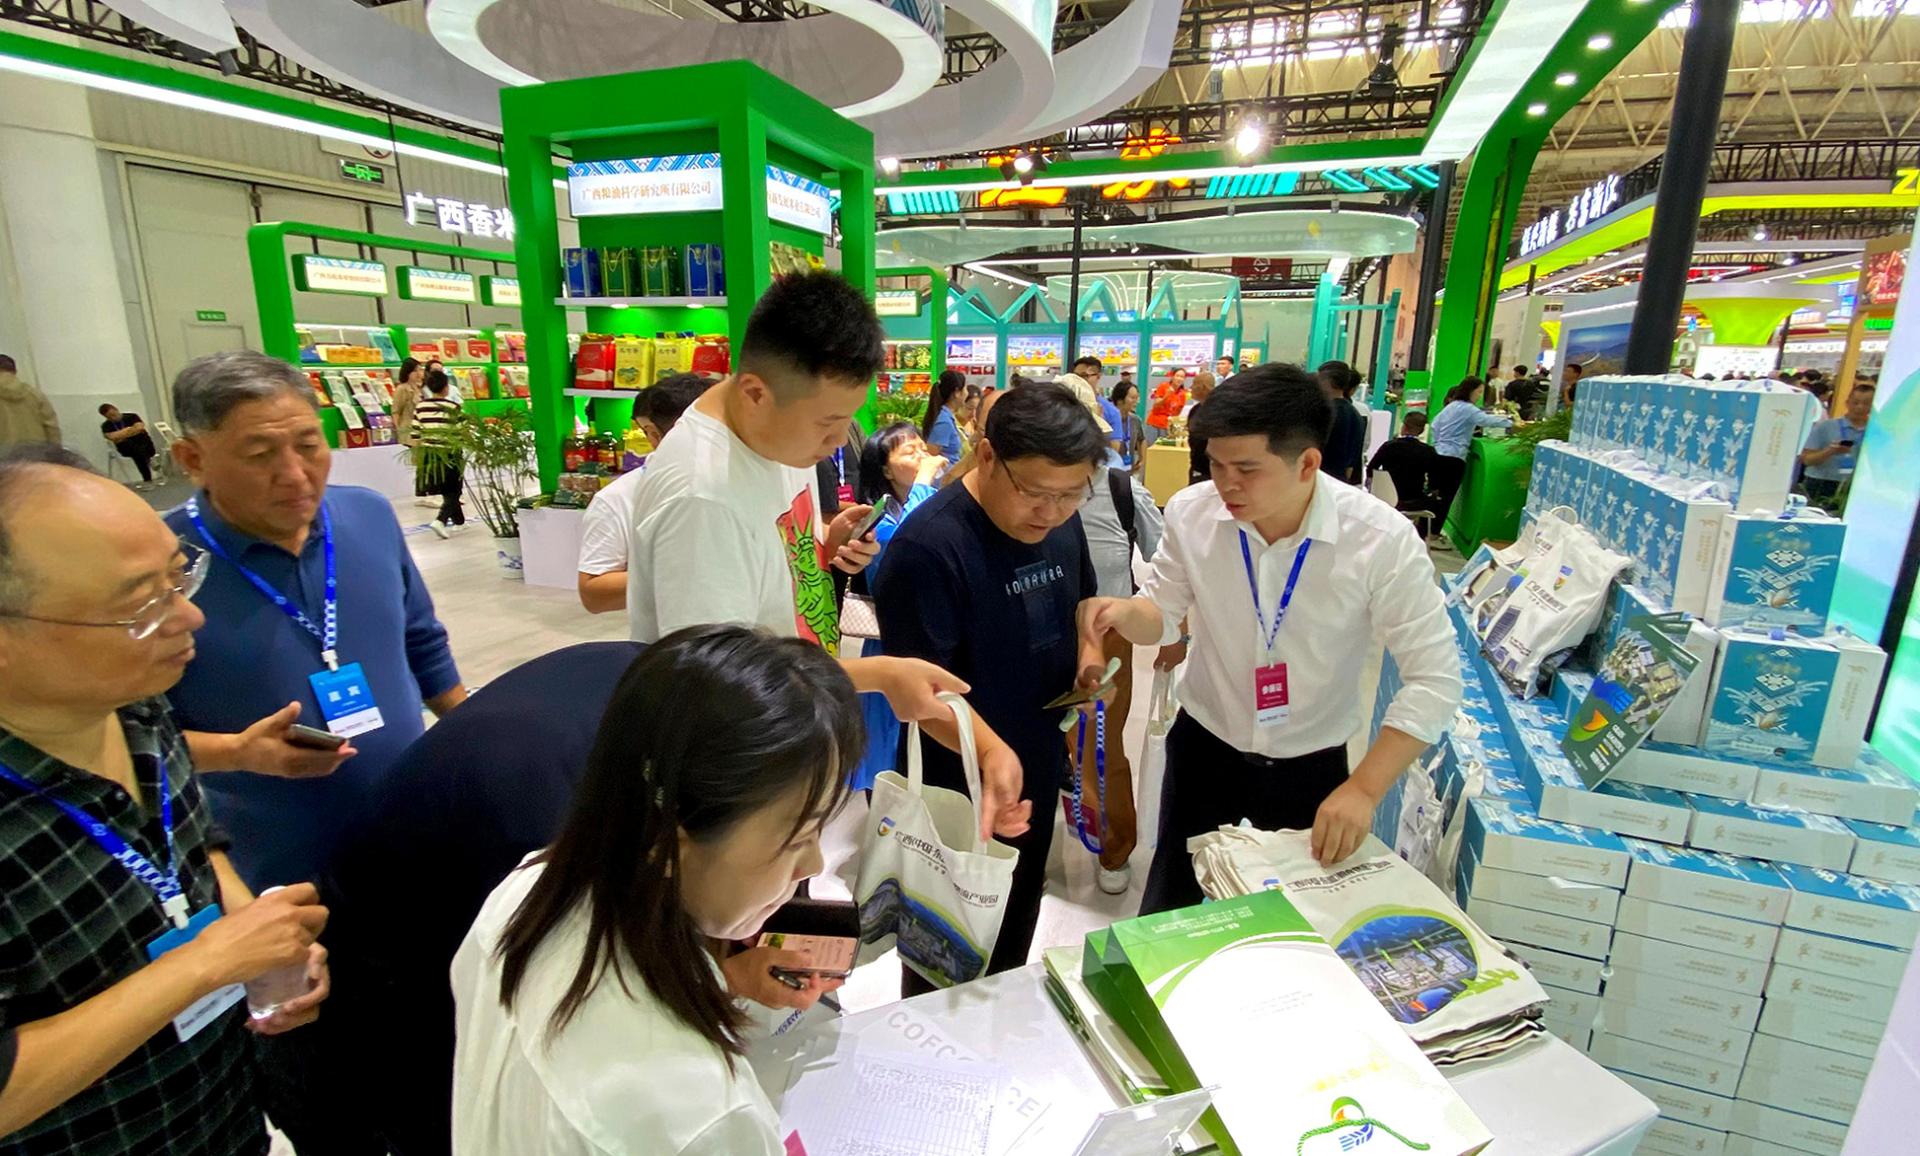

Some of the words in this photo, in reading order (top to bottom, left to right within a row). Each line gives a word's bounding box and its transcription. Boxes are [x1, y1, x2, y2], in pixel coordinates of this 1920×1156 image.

[581, 180, 712, 201] 广西粮油科学研究所有限公司
[887, 1011, 974, 1062] COFC
